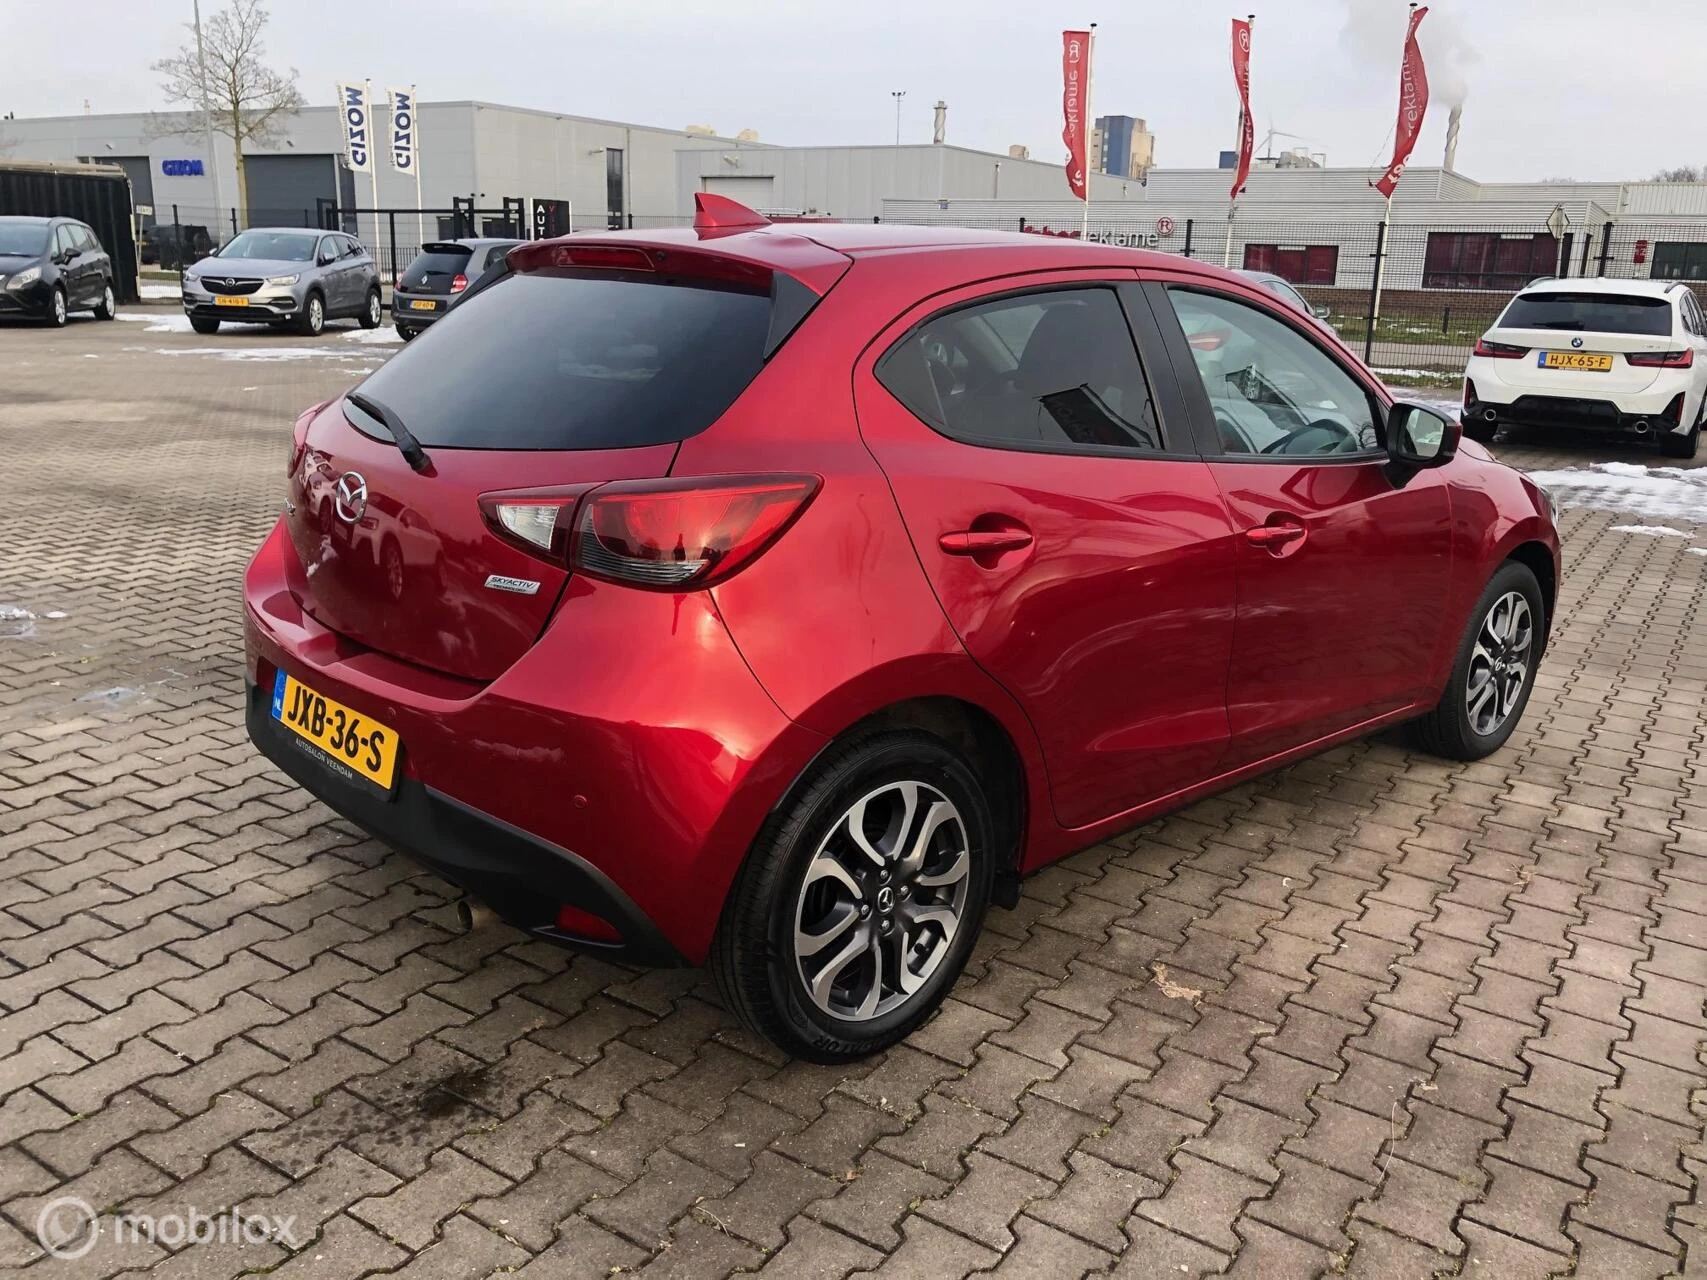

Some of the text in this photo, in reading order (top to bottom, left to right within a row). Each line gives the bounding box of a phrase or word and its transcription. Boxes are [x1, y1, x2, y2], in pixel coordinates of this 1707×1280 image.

[537, 205, 545, 240] AUT
[1550, 354, 1607, 367] HJX-65-F
[491, 576, 533, 589] SKYACTIV
[287, 685, 385, 773] JXB-36-S
[296, 737, 353, 779] AUTOSALON VEENDAM
